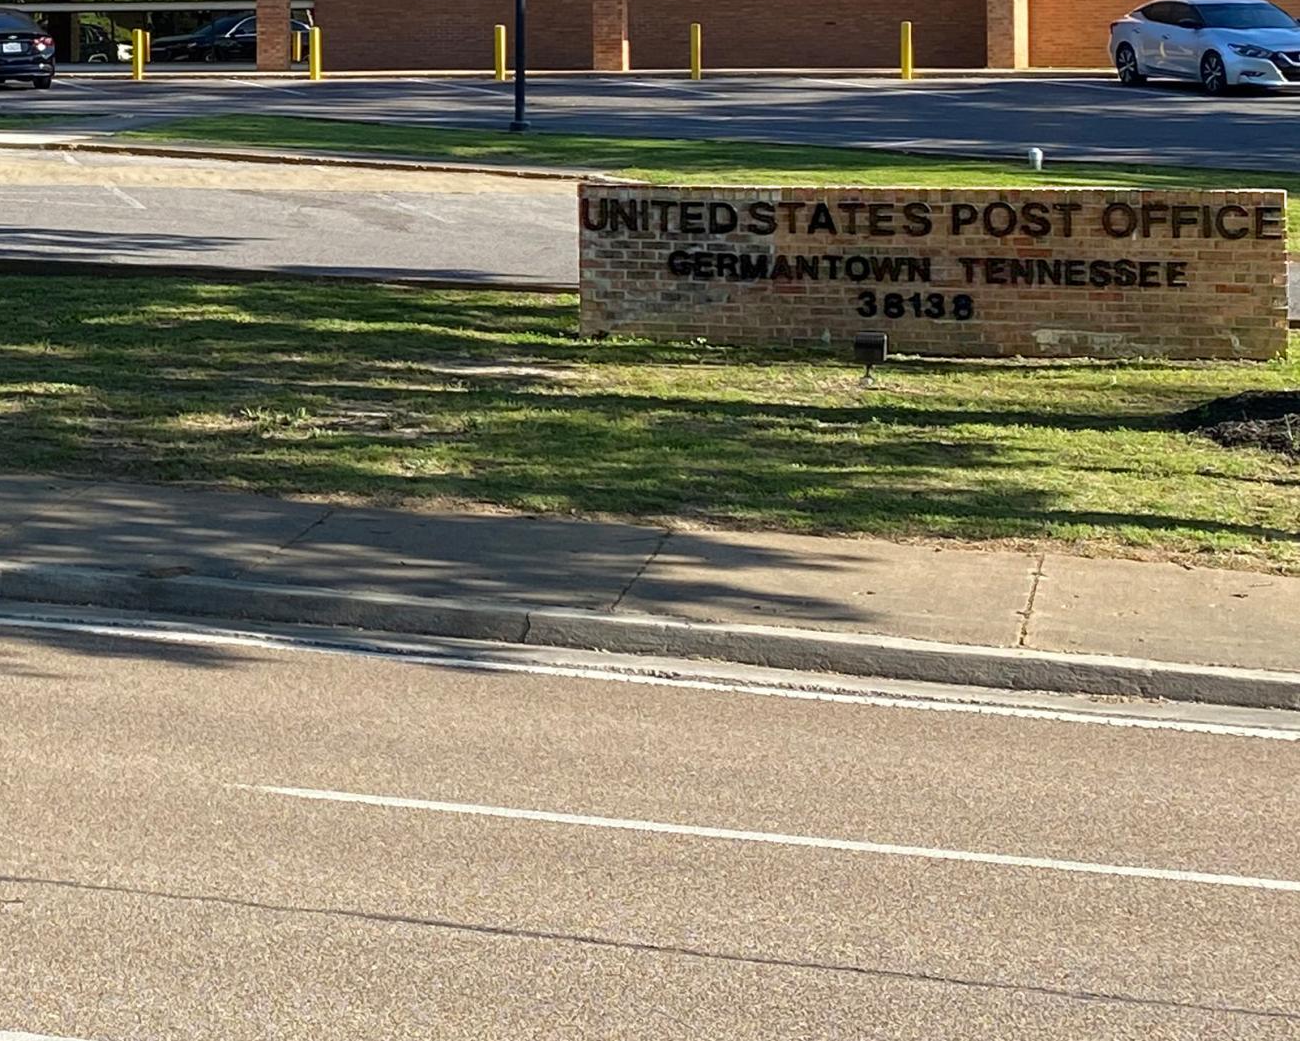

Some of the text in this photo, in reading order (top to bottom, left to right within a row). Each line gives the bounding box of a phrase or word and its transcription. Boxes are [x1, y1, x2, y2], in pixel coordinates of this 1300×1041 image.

[582, 197, 1283, 240] UNITED STATES POST OFFICE
[667, 250, 1189, 288] GERMANTOWN TENNESSEE
[856, 291, 974, 321] 38138
